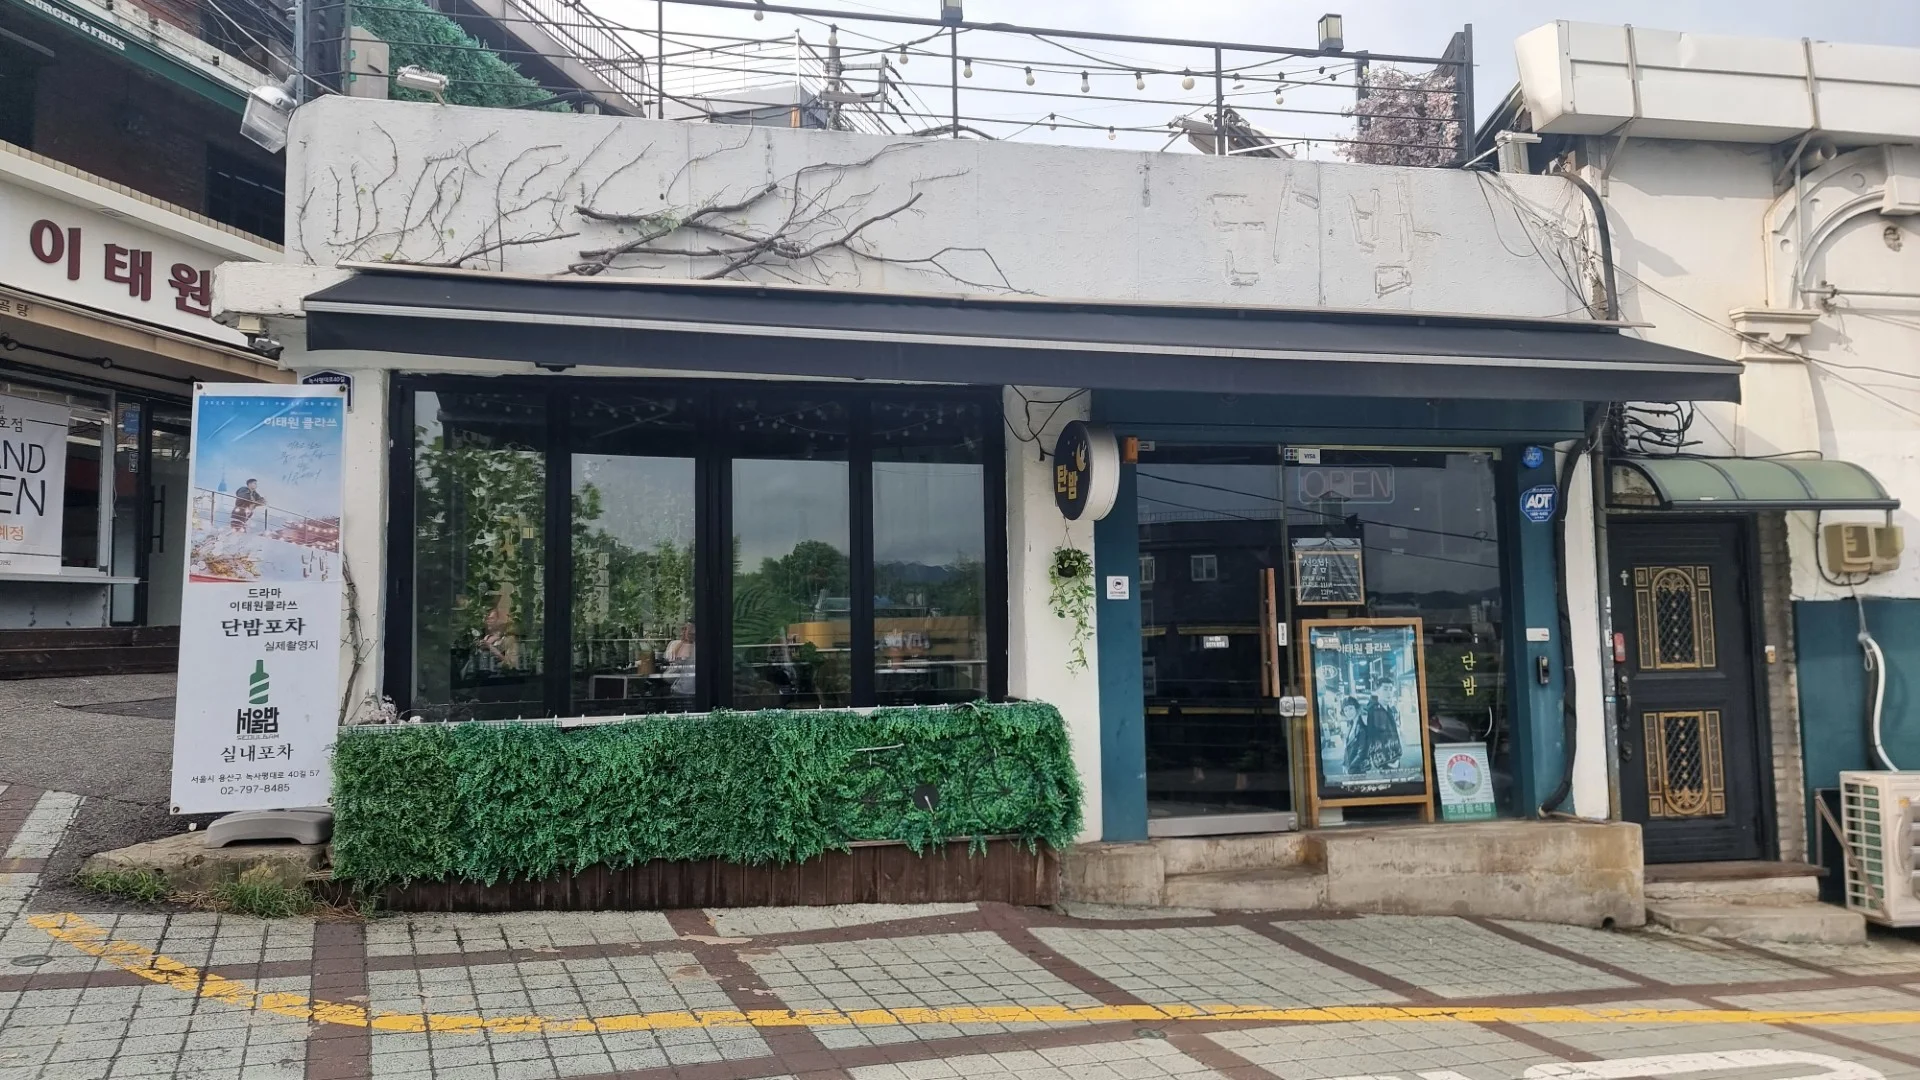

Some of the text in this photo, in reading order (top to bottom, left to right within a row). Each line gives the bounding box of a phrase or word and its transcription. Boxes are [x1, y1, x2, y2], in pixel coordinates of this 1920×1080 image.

[80, 21, 91, 33] &
[90, 25, 125, 50] FRIES
[29, 219, 213, 319] 이태원
[263, 416, 338, 430] 이태원 클라쓰
[0, 439, 46, 474] ND
[1057, 464, 1079, 500] 단밤
[1304, 470, 1391, 498] OPEN
[1526, 494, 1553, 509] ADT
[247, 587, 282, 599] 드라마
[229, 600, 299, 612] 이태원클라쓰
[220, 617, 307, 637] 단밤포차
[264, 640, 319, 652] 실제촬영지
[1364, 642, 1392, 655] 클라쓰
[1461, 651, 1478, 696] 단밤
[236, 706, 280, 735] 서울밤
[236, 733, 280, 741] SEOULBAM
[220, 743, 295, 763] 실내포차
[190, 769, 321, 784] 서울시 용산구 녹사평대로 40길 57
[220, 783, 290, 796] 02-797-8485
